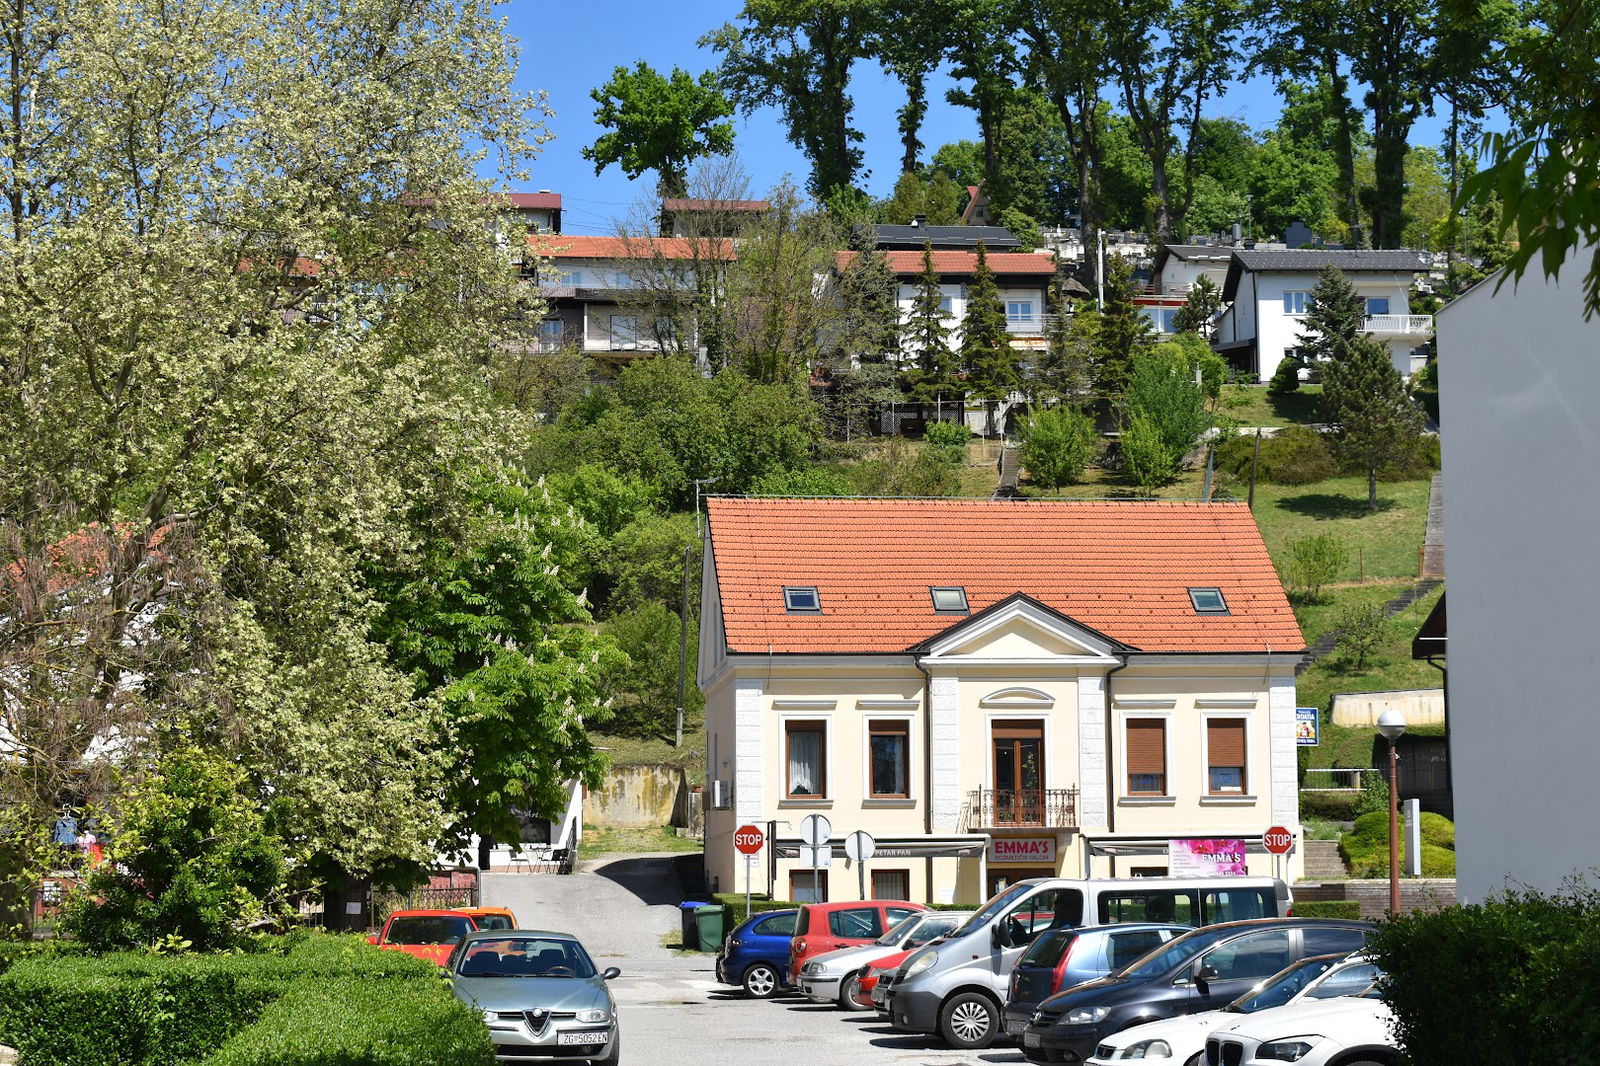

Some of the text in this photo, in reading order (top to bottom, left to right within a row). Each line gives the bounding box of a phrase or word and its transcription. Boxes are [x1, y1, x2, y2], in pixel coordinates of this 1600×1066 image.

[735, 834, 762, 846] STOP
[1265, 834, 1291, 847] STOP
[994, 841, 1049, 854] EMMA'S
[1202, 853, 1242, 863] EMMA'S
